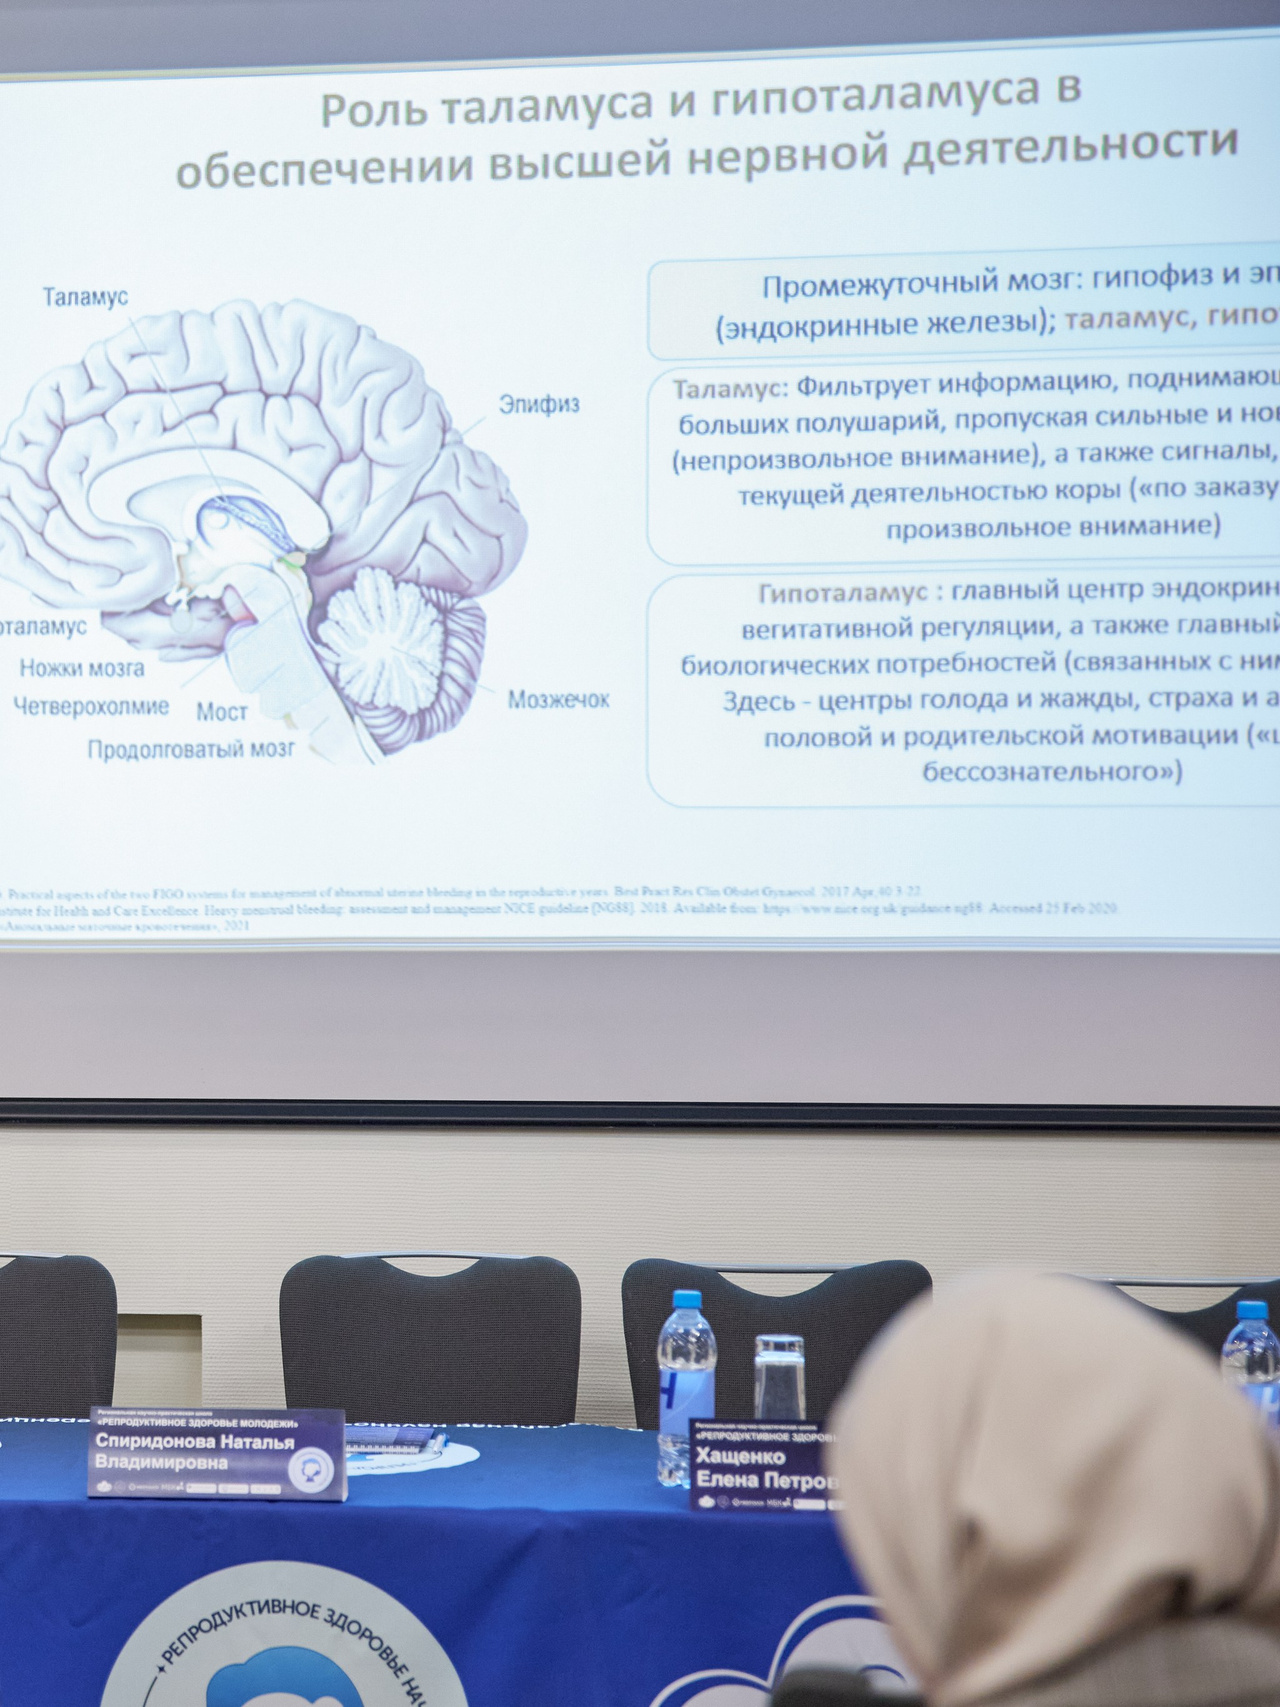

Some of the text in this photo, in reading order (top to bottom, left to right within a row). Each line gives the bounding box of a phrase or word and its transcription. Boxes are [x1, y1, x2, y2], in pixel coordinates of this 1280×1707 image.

[322, 76, 1081, 130] Роль таламуса и гипоталамуса в
[177, 129, 1237, 190] обеспечении высшей нервной деятельности
[763, 266, 998, 304] Промежуточный
[1008, 272, 1082, 291] мозг:
[1094, 262, 1213, 292] гипофиз
[1224, 267, 1239, 285] и
[43, 287, 128, 311] Таламус
[716, 306, 1280, 345] (эндокринные железы); таламус, гипо
[673, 380, 788, 402] Таламус:
[798, 376, 931, 400] Фильтрует
[939, 371, 1118, 397] информацию,
[500, 394, 580, 418] Эпифиз
[680, 414, 789, 436] больших
[796, 409, 946, 437] полушарий,
[955, 411, 1087, 434] пропуская
[1096, 408, 1208, 426] сильные
[1218, 408, 1232, 423] и
[673, 442, 1277, 476] (непроизвольное внимание), а также сигналы,
[738, 482, 844, 510] текущей
[850, 484, 1047, 509] деятельностью
[1056, 483, 1120, 504] коры
[1130, 476, 1186, 503] («по
[887, 512, 1220, 544] произвольное внимание)
[760, 584, 928, 606] Гипоталамус
[952, 578, 1059, 600] главный
[1068, 582, 1144, 604] центр
[743, 616, 913, 640] вегитативной
[922, 620, 1061, 642] регуляции,
[1070, 620, 1083, 635] а
[1092, 619, 1169, 635] также
[20, 658, 145, 678] Ножки мозга
[682, 655, 869, 676] биологических
[877, 650, 1056, 678] потребностей
[1065, 650, 1211, 676] (связанных
[1219, 655, 1232, 670] с
[14, 696, 169, 720] Четверохолмие
[197, 701, 248, 722] Мост
[508, 689, 610, 709] Мозжечок
[723, 691, 796, 716] Здесь
[819, 694, 912, 715] центры
[921, 692, 1008, 713] голода
[1018, 693, 1032, 708] и
[1040, 692, 1140, 712] жажды,
[1149, 691, 1233, 712] страха
[1243, 692, 1257, 707] и
[1267, 691, 1279, 707] а
[765, 724, 1238, 751] половой и родительской мотивации
[88, 739, 295, 764] Продолговатый мозг
[923, 759, 1182, 786] бессознательного»)
[96, 1418, 299, 1430] «РЕПРОДУКТИВНОЕ ЗДОРОВЬЕ МОЛОДЕЖИ»
[95, 1432, 295, 1450] Спиридонова Наталья
[792, 1433, 836, 1443] ЗДОРОВ
[95, 1454, 229, 1472] Владимировна
[696, 1446, 787, 1467] Хащенко
[697, 1470, 759, 1488] Елена
[161, 1599, 322, 1665] РЕПРОДУКТИВНОЕ
[323, 1608, 409, 1679] ЗДОРОВЬЕ
